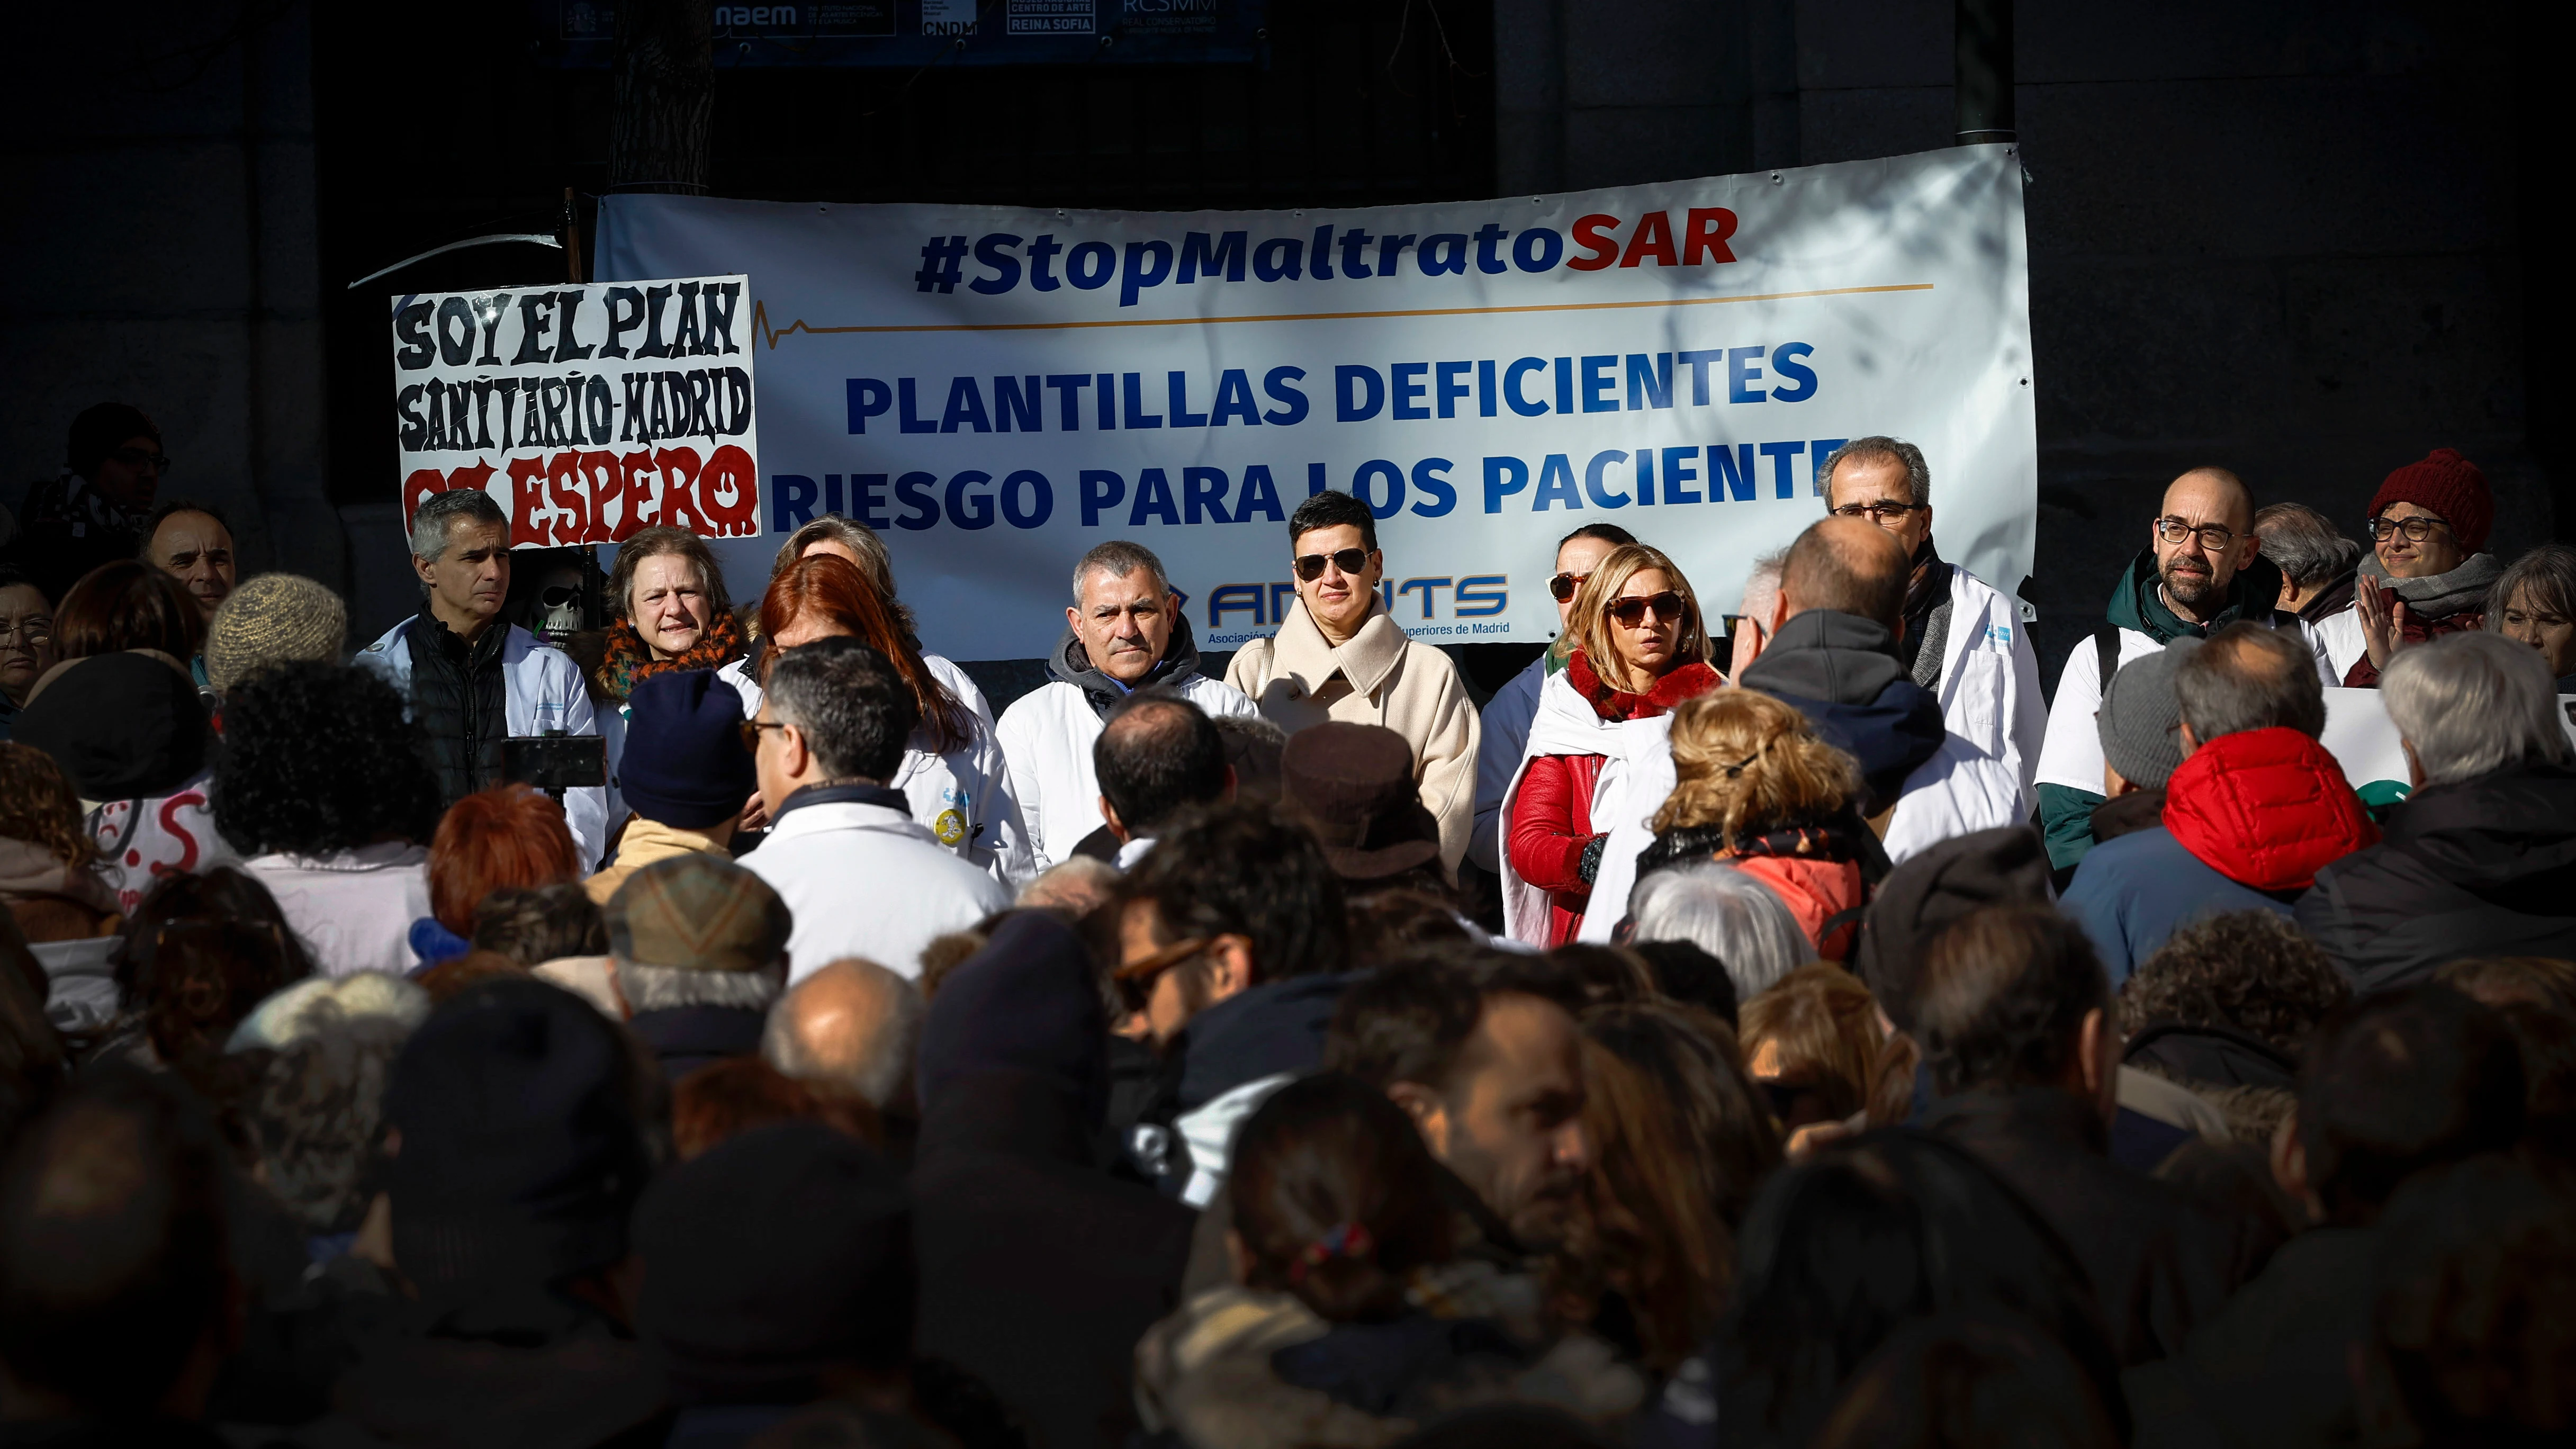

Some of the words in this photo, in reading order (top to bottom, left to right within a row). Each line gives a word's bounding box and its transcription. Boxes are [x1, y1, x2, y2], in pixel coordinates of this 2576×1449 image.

[923, 21, 976, 35] CNDM
[1012, 19, 1051, 30] REINA
[1053, 19, 1091, 30] SOFIA
[1064, 3, 1092, 12] ARTE
[1122, 17, 1145, 26] REAL
[1146, 16, 1217, 26] CONSERVATORIO
[915, 207, 1738, 308] #StopMaltratoSAR
[395, 293, 512, 371] SOY
[510, 290, 597, 367] EL
[598, 281, 742, 361] PLAN
[846, 366, 1310, 435] PLANTILLAS
[1335, 341, 1819, 422] DEFICIENTES
[506, 444, 758, 547] ESPERO
[771, 469, 1054, 532] RIESGO
[1079, 464, 1286, 526] PARA
[1401, 625, 1453, 638] uperiores
[1456, 624, 1469, 634] de
[1472, 622, 1510, 634] Madrid
